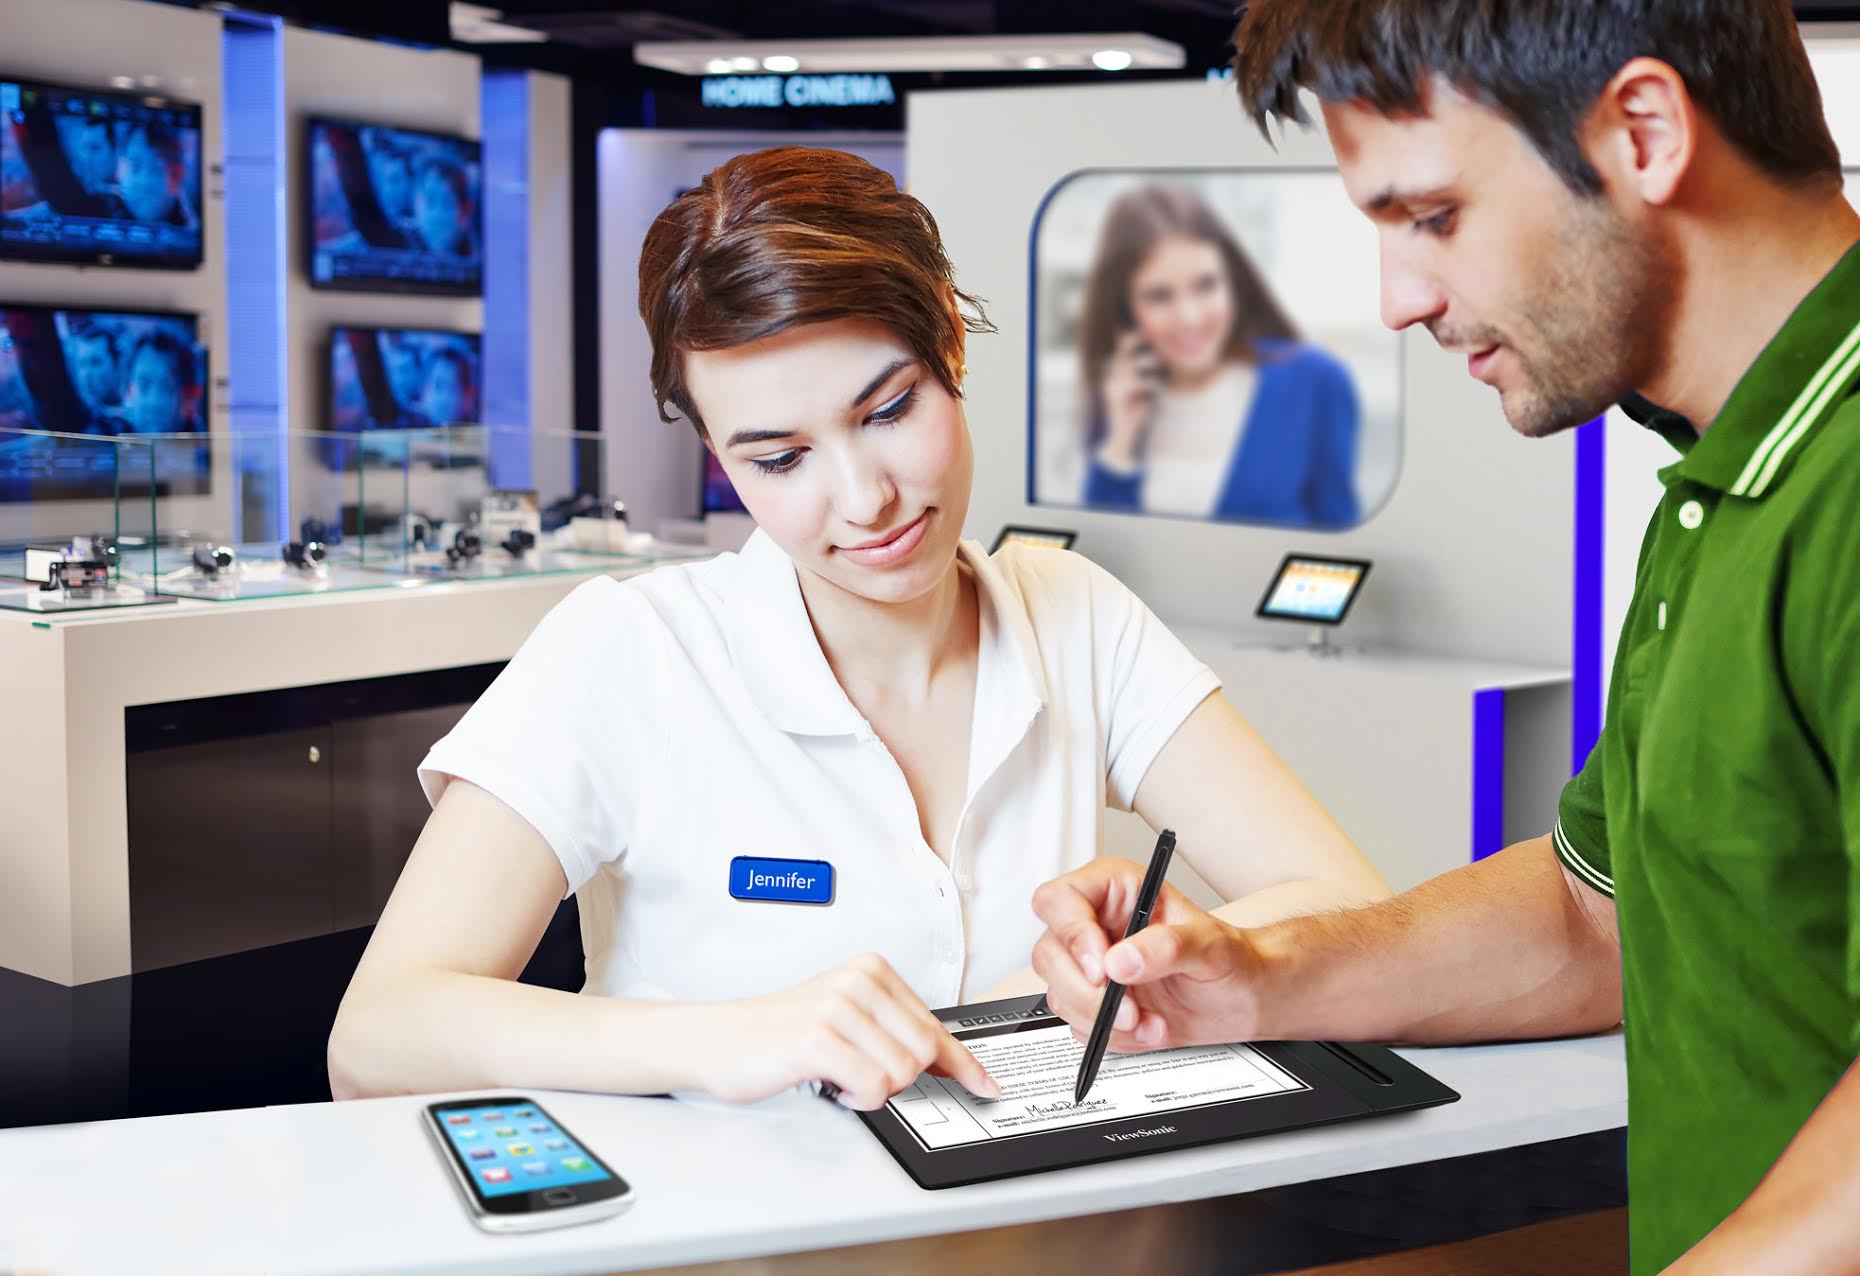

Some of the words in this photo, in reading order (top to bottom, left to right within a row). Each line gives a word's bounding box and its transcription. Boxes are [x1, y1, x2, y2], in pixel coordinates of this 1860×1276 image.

[702, 75, 784, 107] HOME
[785, 74, 896, 106] CINEMA
[746, 869, 816, 890] Jennifer
[1103, 1125, 1178, 1142] ViewSonic
